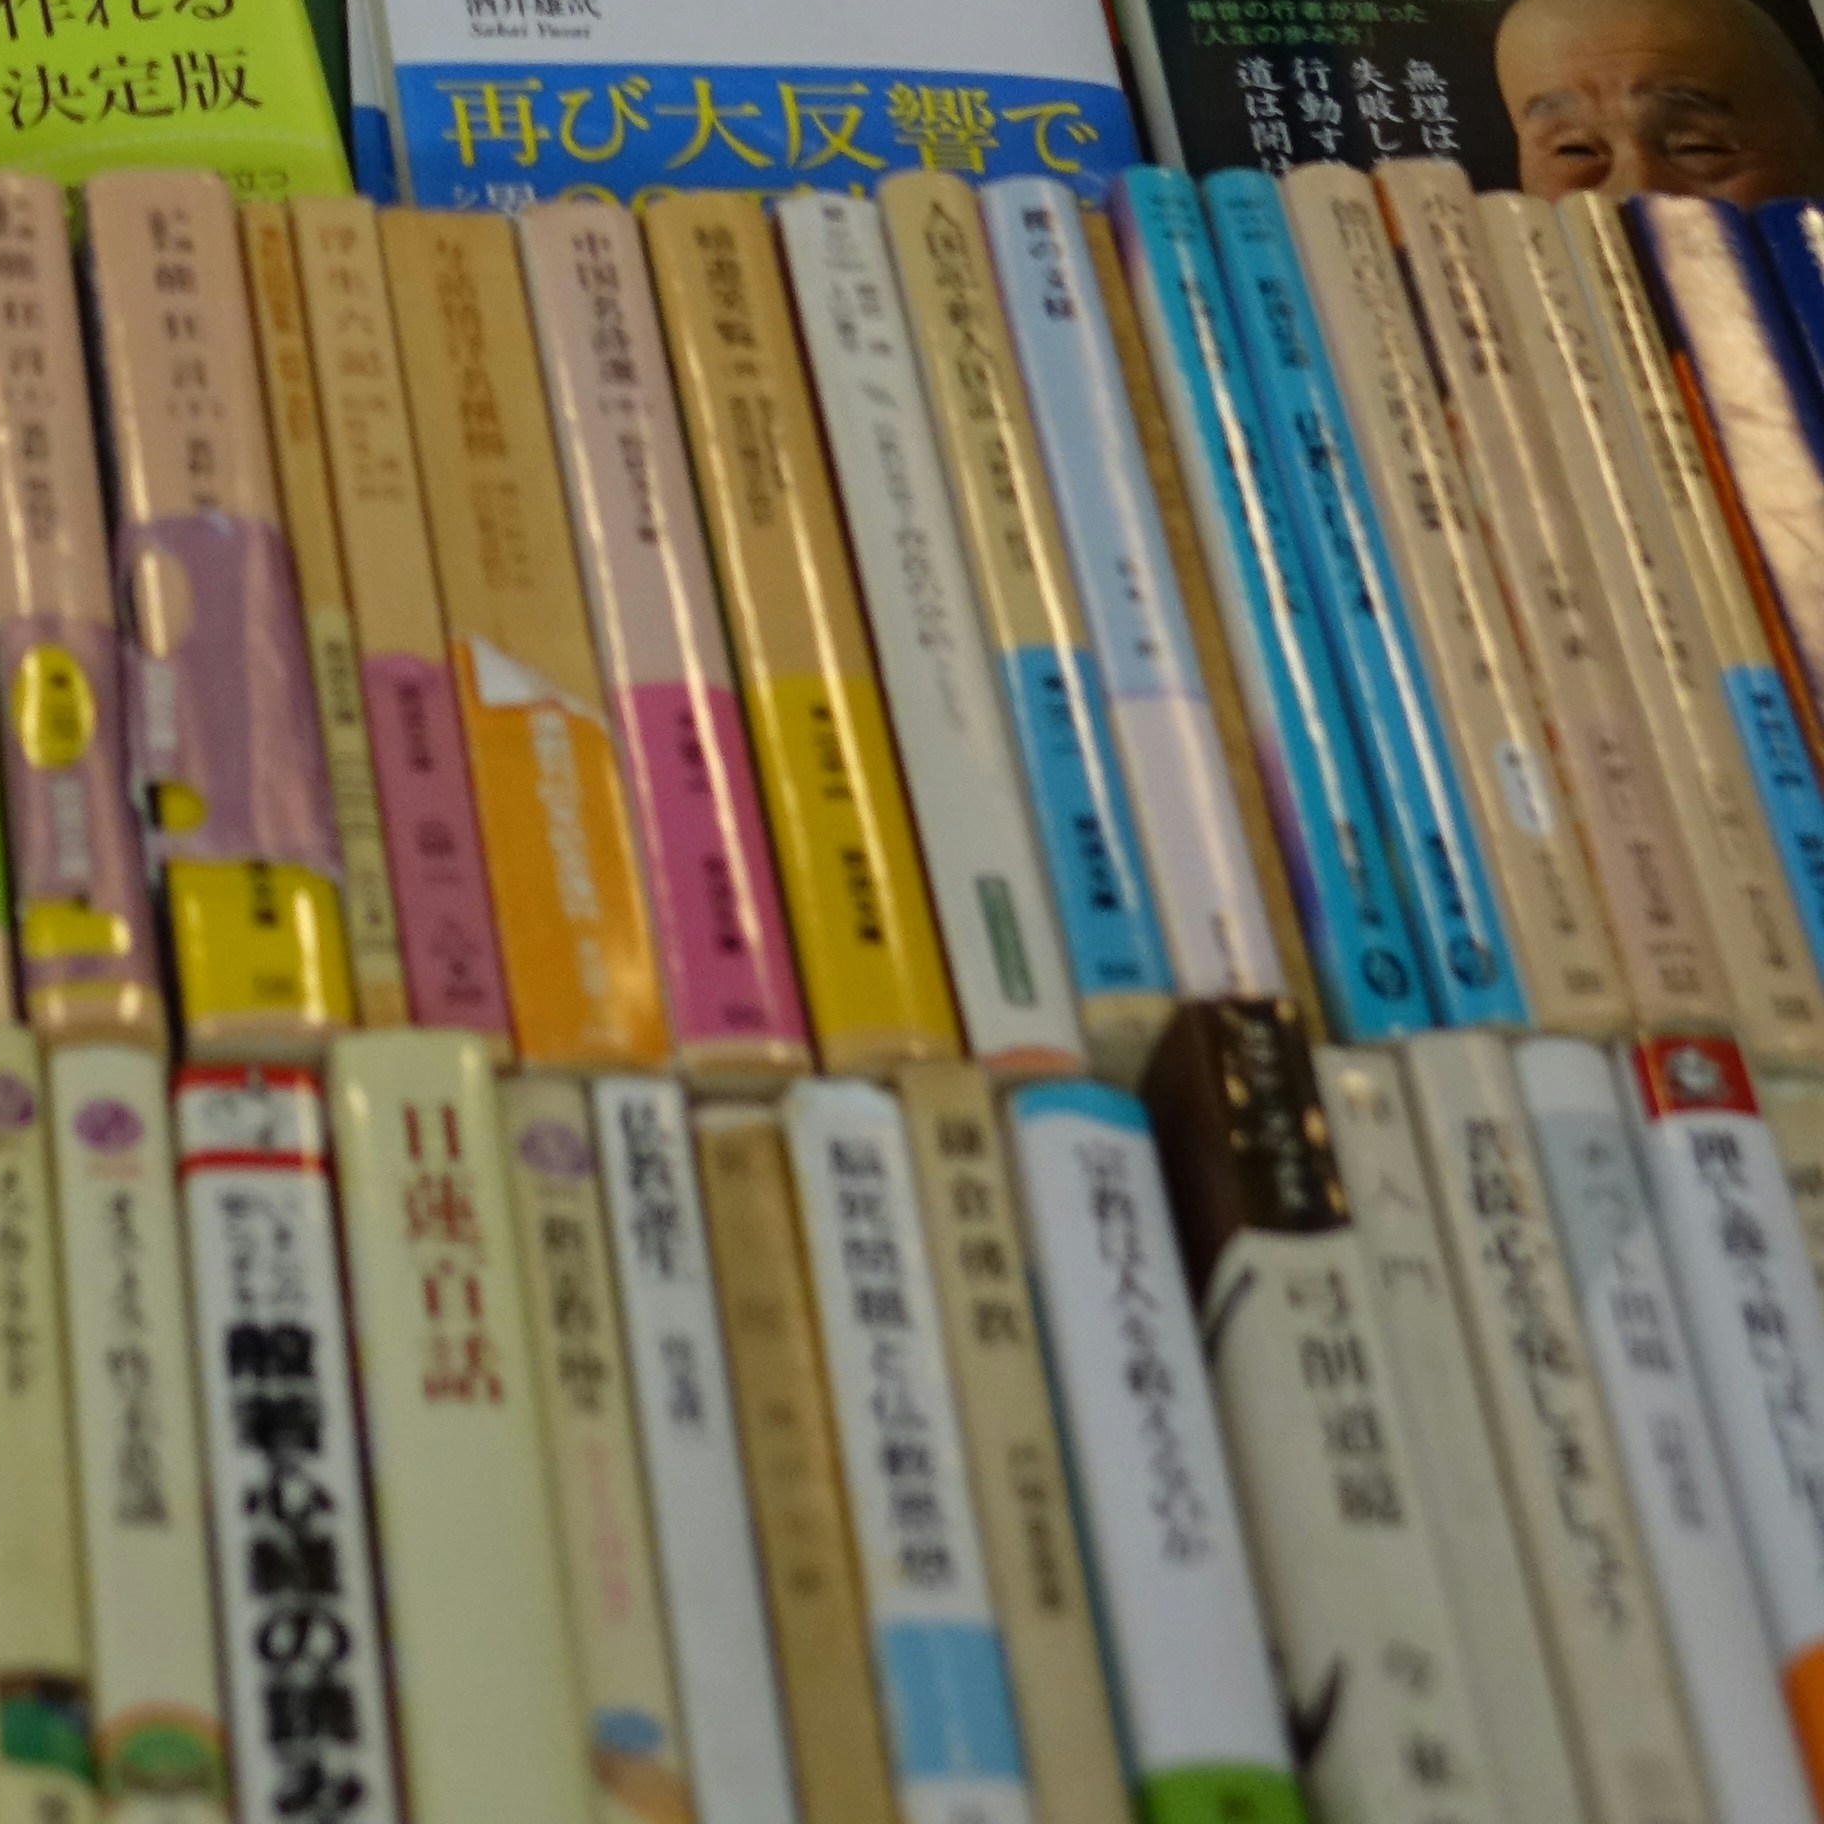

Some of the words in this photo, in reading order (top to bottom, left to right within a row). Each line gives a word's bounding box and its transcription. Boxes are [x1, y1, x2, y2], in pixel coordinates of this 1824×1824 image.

[432, 74, 1103, 172] 再び大反響で
[1290, 55, 1346, 164] 行動す
[1349, 55, 1404, 164] 失敗し
[1400, 57, 1462, 164] 無理は
